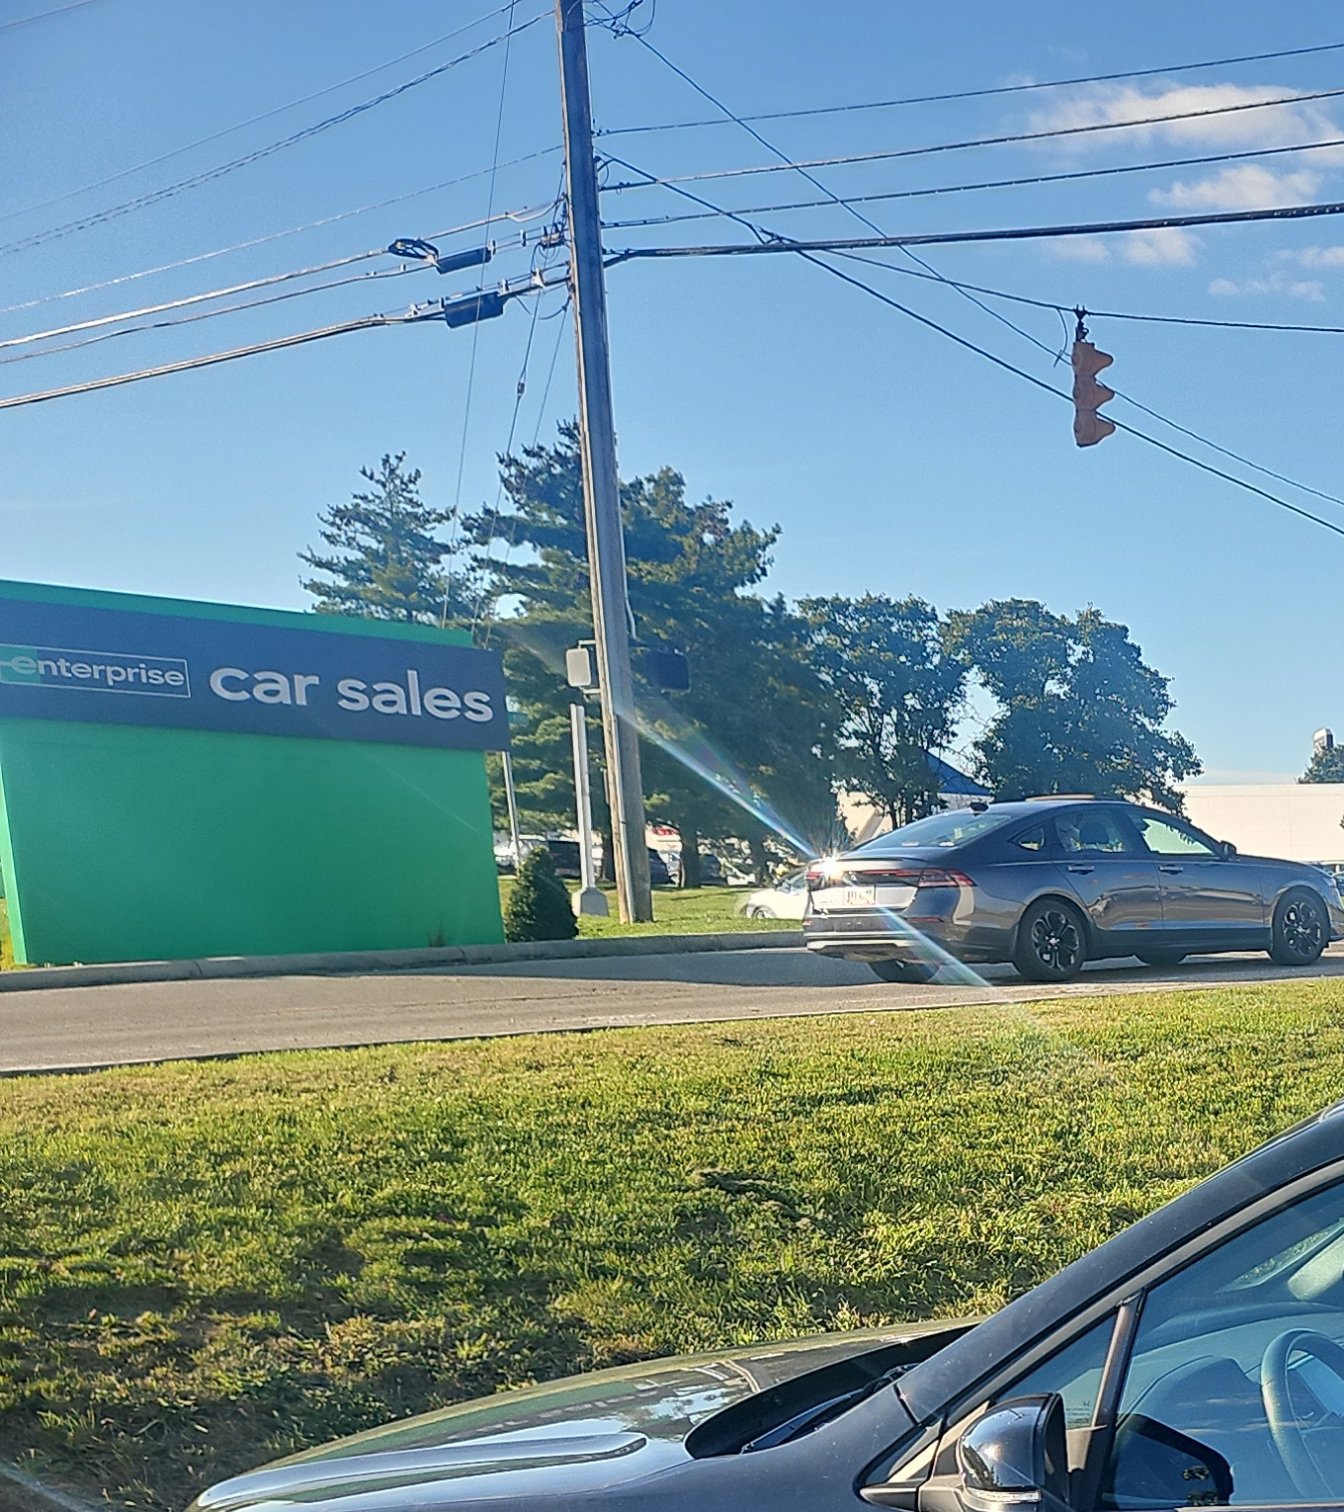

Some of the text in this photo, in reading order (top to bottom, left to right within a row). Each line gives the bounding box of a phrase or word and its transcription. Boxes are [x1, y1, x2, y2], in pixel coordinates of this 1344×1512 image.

[10, 656, 185, 686] enterprise
[209, 667, 494, 722] car sales
